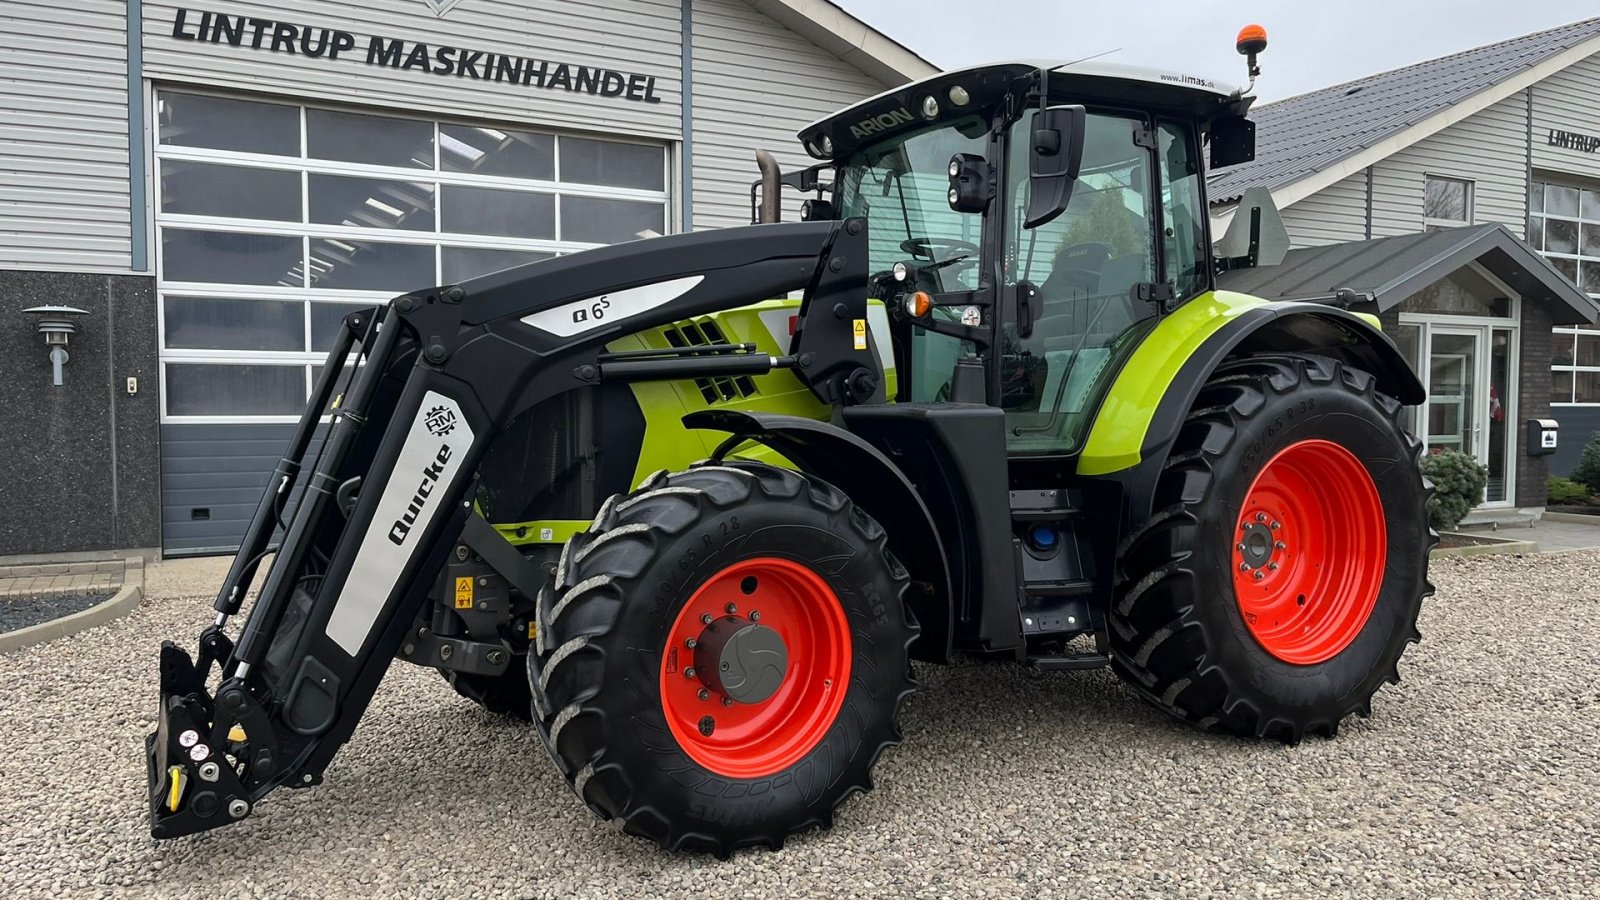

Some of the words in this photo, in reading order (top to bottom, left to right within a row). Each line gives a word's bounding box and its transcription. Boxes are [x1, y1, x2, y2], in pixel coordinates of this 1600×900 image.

[172, 8, 355, 61] LINTRUP
[365, 36, 662, 104] MASKINHANDEL
[1160, 74, 1215, 88] www.limas.dk
[849, 106, 915, 139] ARION
[1547, 129, 1600, 153] LINTRUP
[425, 410, 456, 432] RM
[388, 443, 452, 546] Quicke
[719, 516, 741, 536] 28
